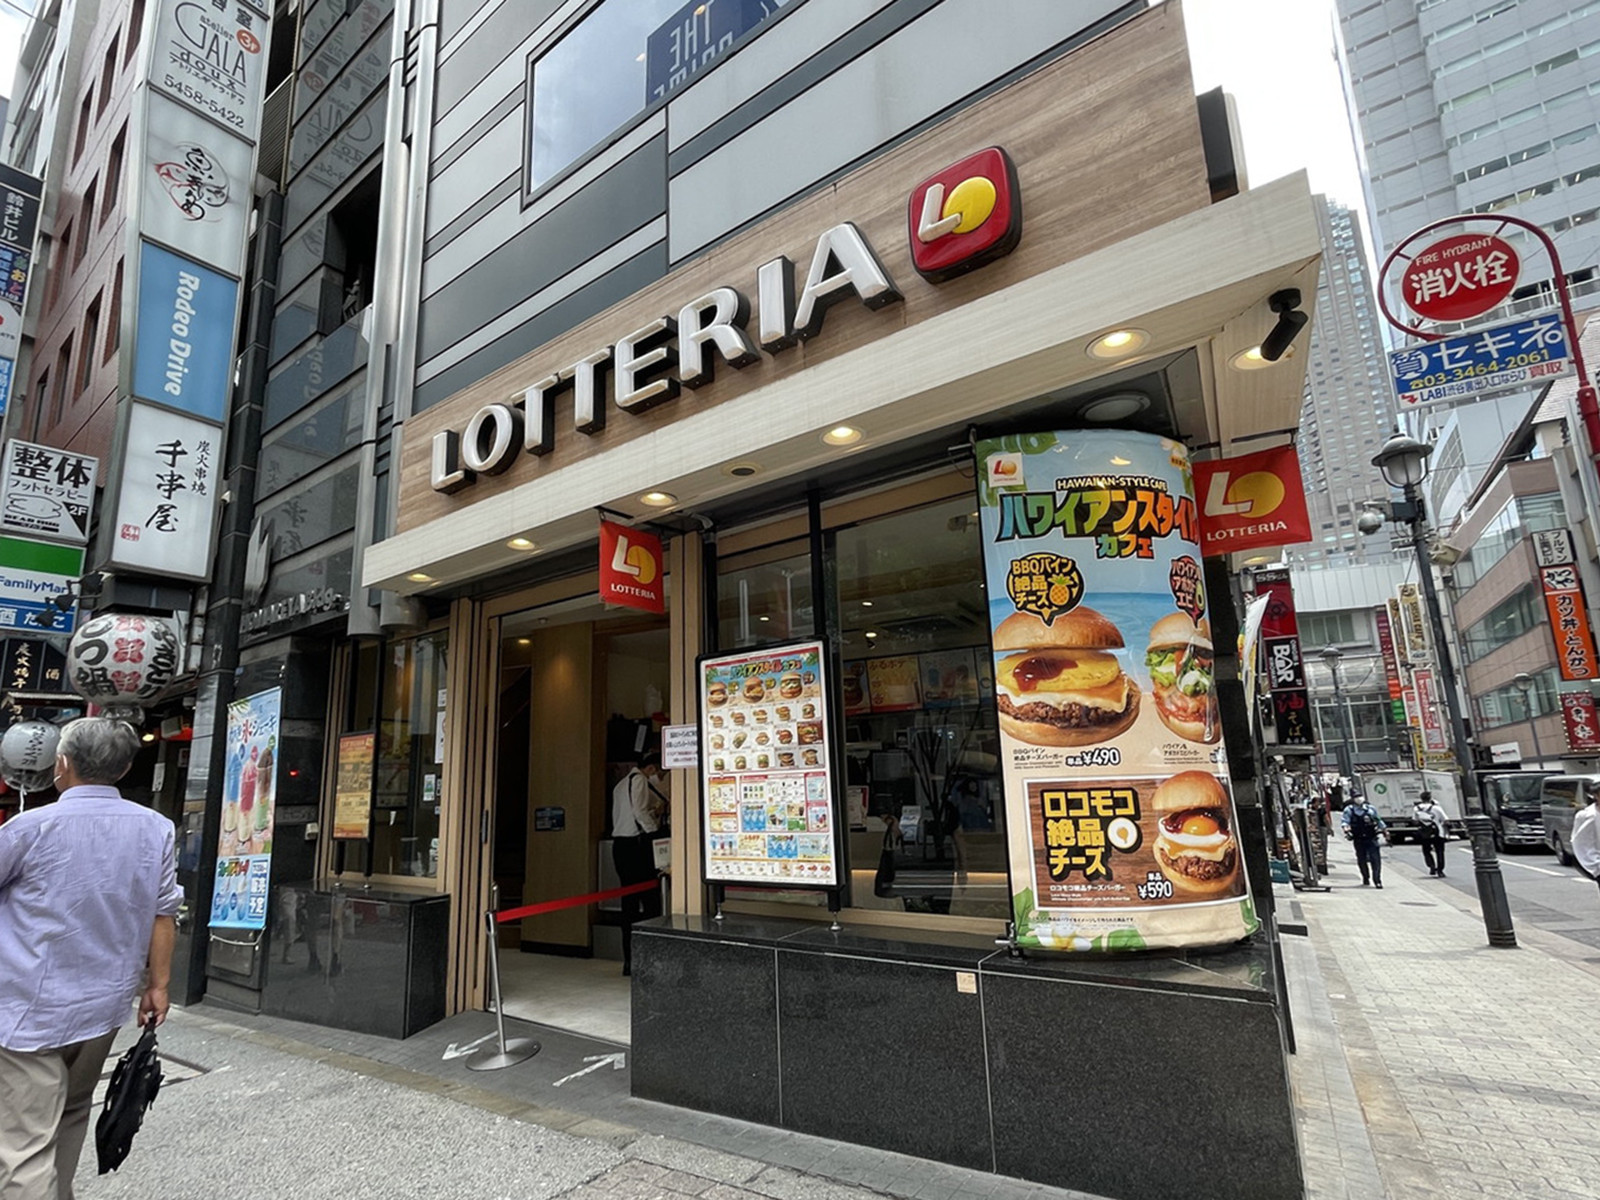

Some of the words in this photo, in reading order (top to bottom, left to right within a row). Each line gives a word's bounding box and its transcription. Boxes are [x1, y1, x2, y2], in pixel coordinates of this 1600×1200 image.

[175, 2, 246, 83] GALA
[180, 50, 236, 91] doux
[164, 73, 244, 128] 5458-5422
[1415, 253, 1440, 267] FIRE
[1442, 236, 1494, 260] HYDRANT
[1409, 250, 1513, 305] 消火栓
[172, 271, 201, 337] Rodeo
[430, 221, 902, 494] LOTTERIA
[1432, 320, 1563, 371] セキネ
[163, 339, 192, 397] Drive
[1423, 349, 1551, 388] 03-3464-2061
[1528, 361, 1564, 379] 買取
[11, 446, 92, 489] 整体
[69, 504, 87, 517] 2F
[1098, 533, 1153, 558] カフェ
[1206, 521, 1287, 542] LOTTERIA
[1012, 557, 1073, 575] BBQパイン
[0, 575, 70, 594] FamilyMar
[610, 583, 656, 600] LOTTERIA
[1015, 591, 1049, 608] チーズ
[23, 611, 66, 629] たこ
[1273, 644, 1295, 683] BAR
[1083, 748, 1120, 765] ¥490
[1043, 789, 1136, 818] ロコモコ
[1046, 818, 1106, 848] 絶品
[1049, 847, 1107, 876] チーズ
[1138, 881, 1173, 899] ¥590
